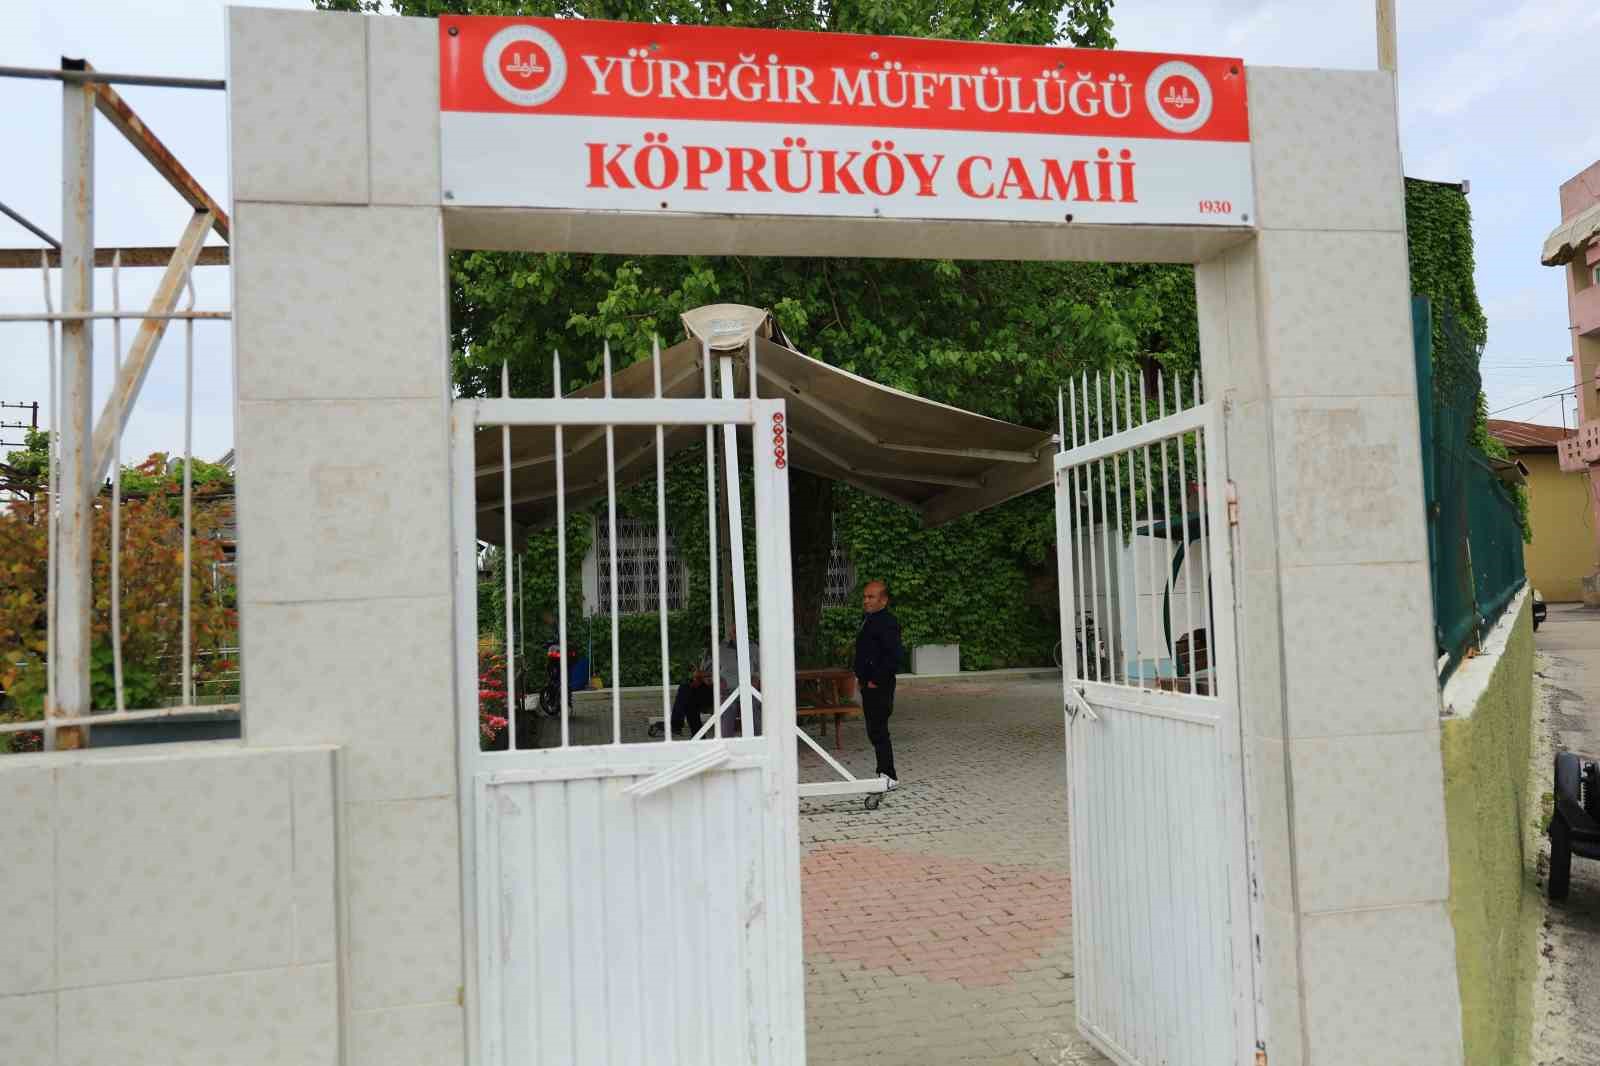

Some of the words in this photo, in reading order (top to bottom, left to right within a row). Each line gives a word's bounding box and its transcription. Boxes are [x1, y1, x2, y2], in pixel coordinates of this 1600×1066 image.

[581, 47, 820, 105] YÜREĞİR
[830, 60, 1133, 118] MÜFTÜLÜĞÜ
[585, 132, 943, 198] KÖPRÜKÖY
[957, 147, 1137, 203] CAMİİ
[1198, 201, 1233, 214] 1930
